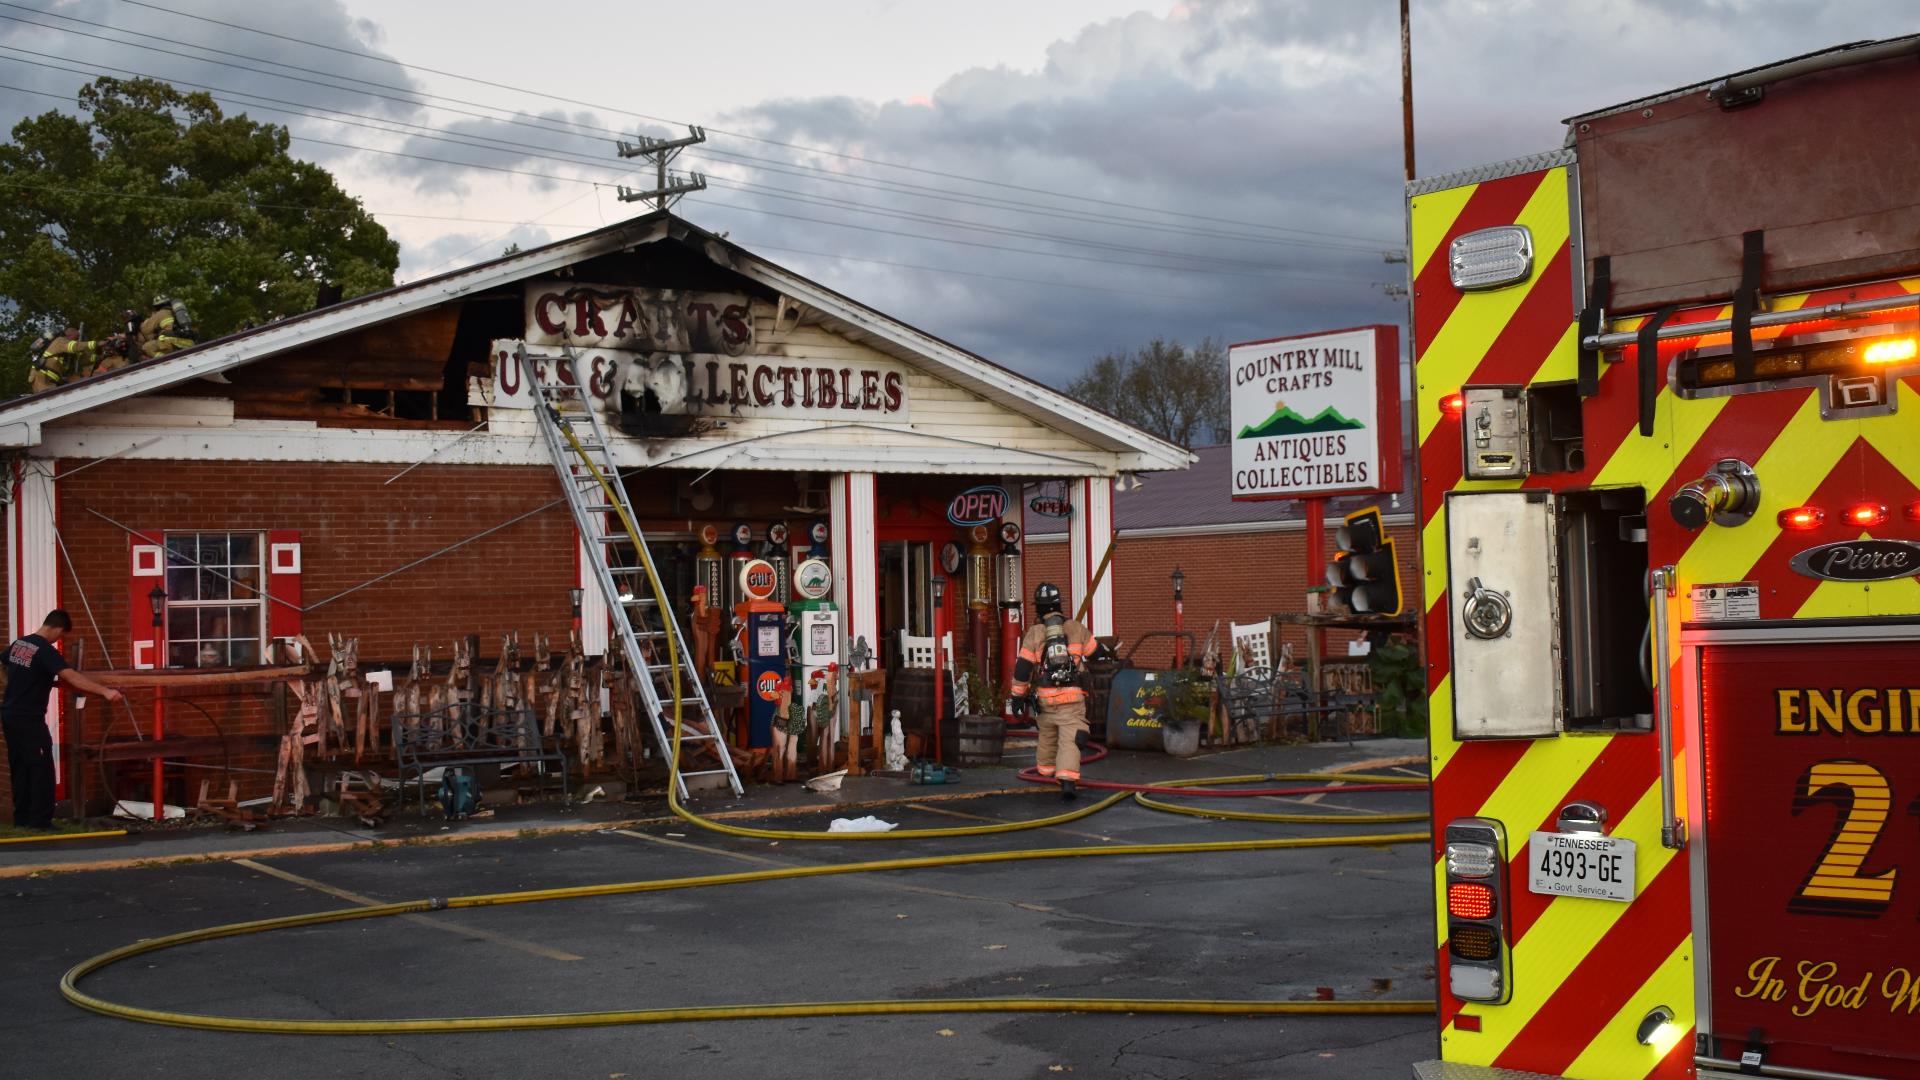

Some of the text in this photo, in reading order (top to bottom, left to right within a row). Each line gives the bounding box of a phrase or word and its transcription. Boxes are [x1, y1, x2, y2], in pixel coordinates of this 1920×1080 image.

[590, 355, 618, 400] &
[1236, 348, 1363, 386] COUNTRY MILL
[1266, 371, 1333, 393] CRAFTS
[1254, 435, 1346, 462] ANTIQUES
[1236, 461, 1367, 490] COLLECTIBLES
[953, 494, 1003, 519] OPEN
[1034, 500, 1070, 514] OPEN
[1823, 546, 1909, 575] Pierce
[748, 572, 774, 588] GULF
[1776, 688, 1920, 733] ENGI
[1554, 837, 1609, 851] TENNESSEE
[1541, 849, 1622, 883] 4393-GE
[1577, 884, 1607, 896] Service
[1735, 956, 1787, 1002] In
[1792, 960, 1872, 1017] God
